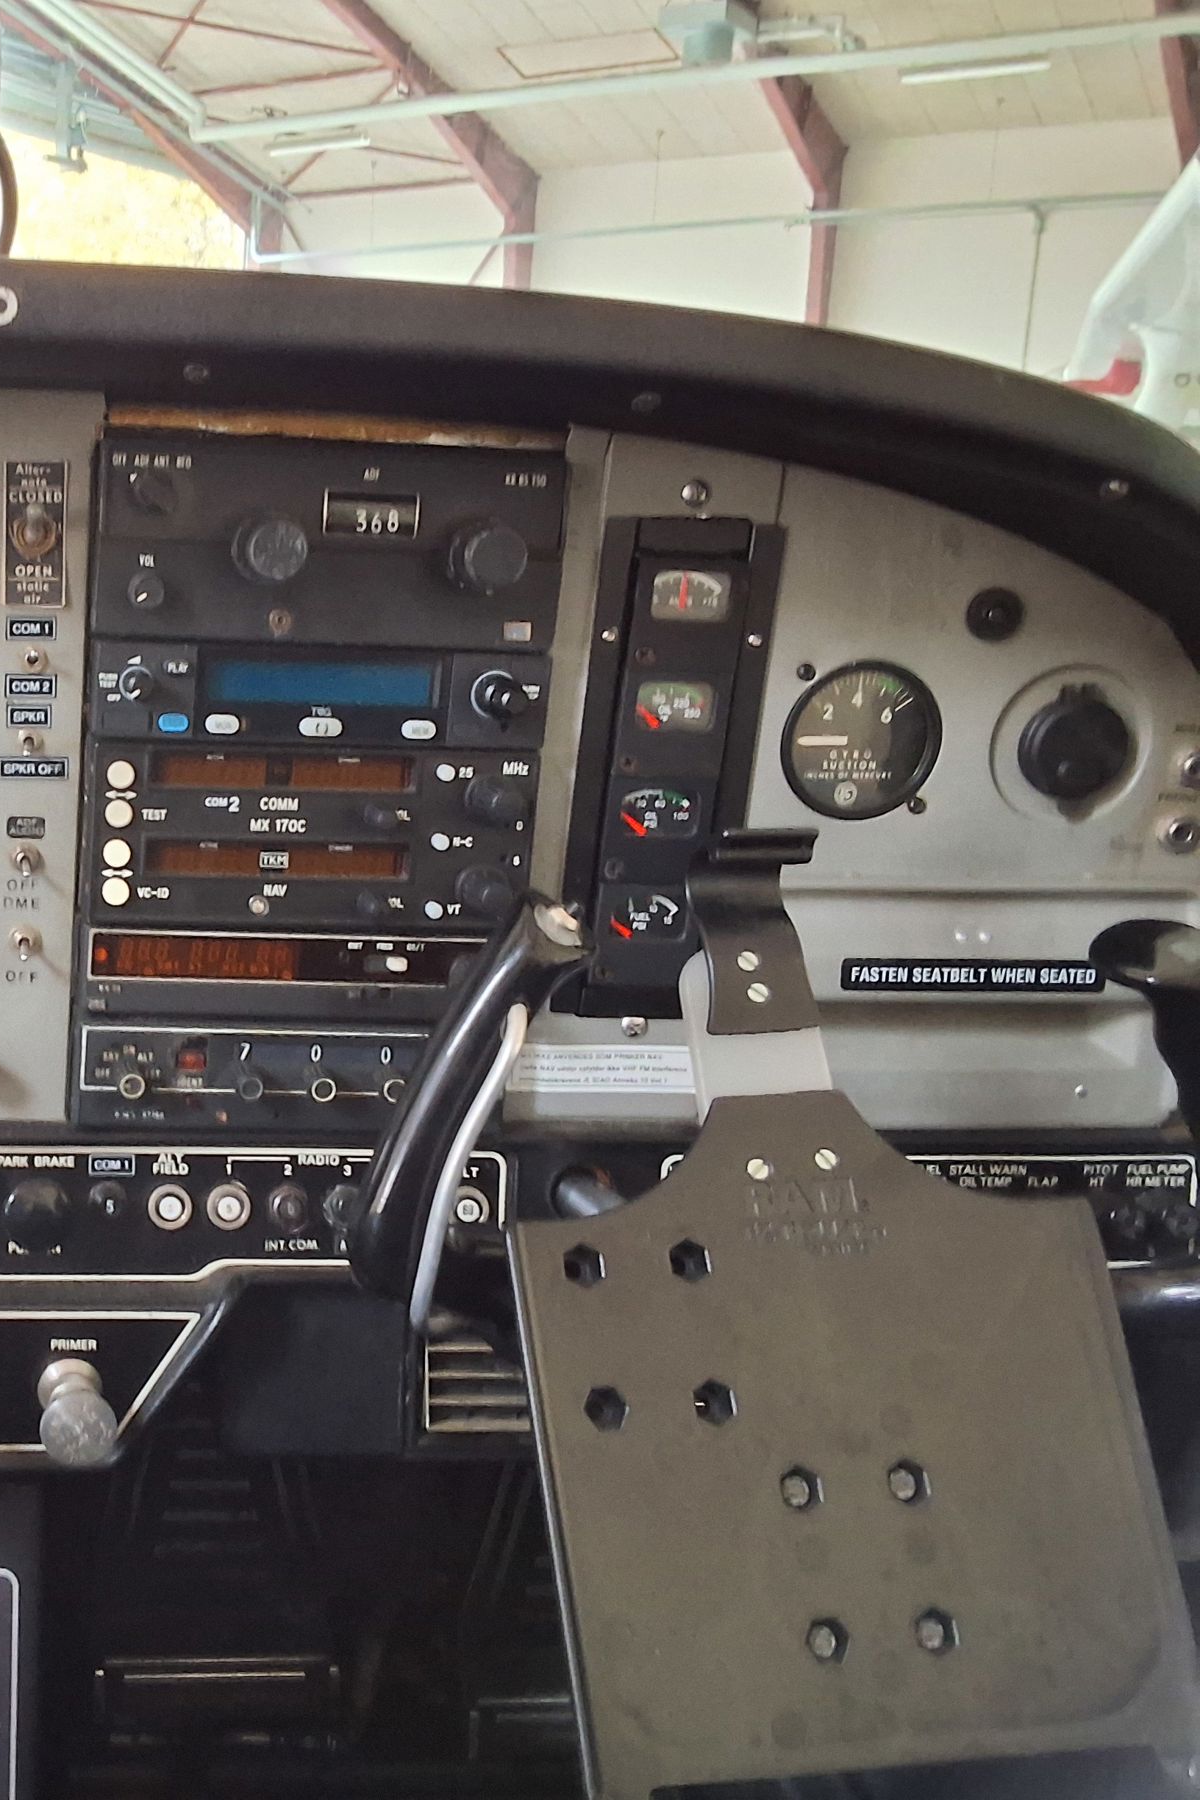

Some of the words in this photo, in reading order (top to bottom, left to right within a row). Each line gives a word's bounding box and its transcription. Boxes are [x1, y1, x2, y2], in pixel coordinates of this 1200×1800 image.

[9, 491, 62, 503] CLOSED
[356, 508, 399, 534] 368
[139, 554, 154, 567] VOL
[15, 564, 52, 577] OPEN
[12, 623, 41, 635] COM
[12, 682, 40, 692] COM
[43, 682, 50, 692] 2
[13, 711, 45, 722] SPKR
[823, 703, 834, 720] 2
[881, 706, 893, 724] 6
[3, 764, 35, 775] SPKR
[38, 765, 62, 775] OFF
[503, 761, 529, 776] MHz
[823, 760, 877, 770] SUCTION
[205, 797, 228, 807] COM
[228, 796, 240, 812] 2
[260, 797, 298, 811] COMM
[142, 809, 167, 821] TEST
[250, 819, 270, 832] MX
[275, 819, 306, 833] 170C
[263, 855, 286, 865] TKM
[263, 884, 288, 897] NAV
[851, 966, 908, 983] FASTEN
[912, 967, 987, 983] SEATBELT
[991, 968, 1035, 984] WHEN
[1040, 968, 1096, 985] SEATED
[240, 1042, 250, 1061] 7
[311, 1044, 322, 1063] 0
[381, 1047, 392, 1065] 0
[34, 1155, 75, 1168] BRAKE
[158, 1153, 184, 1164] ALT
[298, 1155, 340, 1166] RADIO
[94, 1160, 120, 1170] COM
[153, 1163, 189, 1175] FIELD
[284, 1164, 293, 1176] 2
[343, 1165, 352, 1176] 3
[950, 1165, 984, 1175] STALL
[991, 1165, 1027, 1176] WARN
[1083, 1165, 1119, 1175] PITOT
[1127, 1165, 1156, 1175] FUEL
[1157, 1165, 1190, 1175] PUMP
[462, 1166, 479, 1178] LT
[960, 1176, 977, 1187] OIL
[980, 1177, 1012, 1187] TEMP
[1028, 1177, 1059, 1187] FLAP
[1089, 1177, 1105, 1187] HT
[1126, 1177, 1143, 1187] HR
[1145, 1177, 1185, 1187] METER
[50, 1338, 97, 1351] PRIMER
